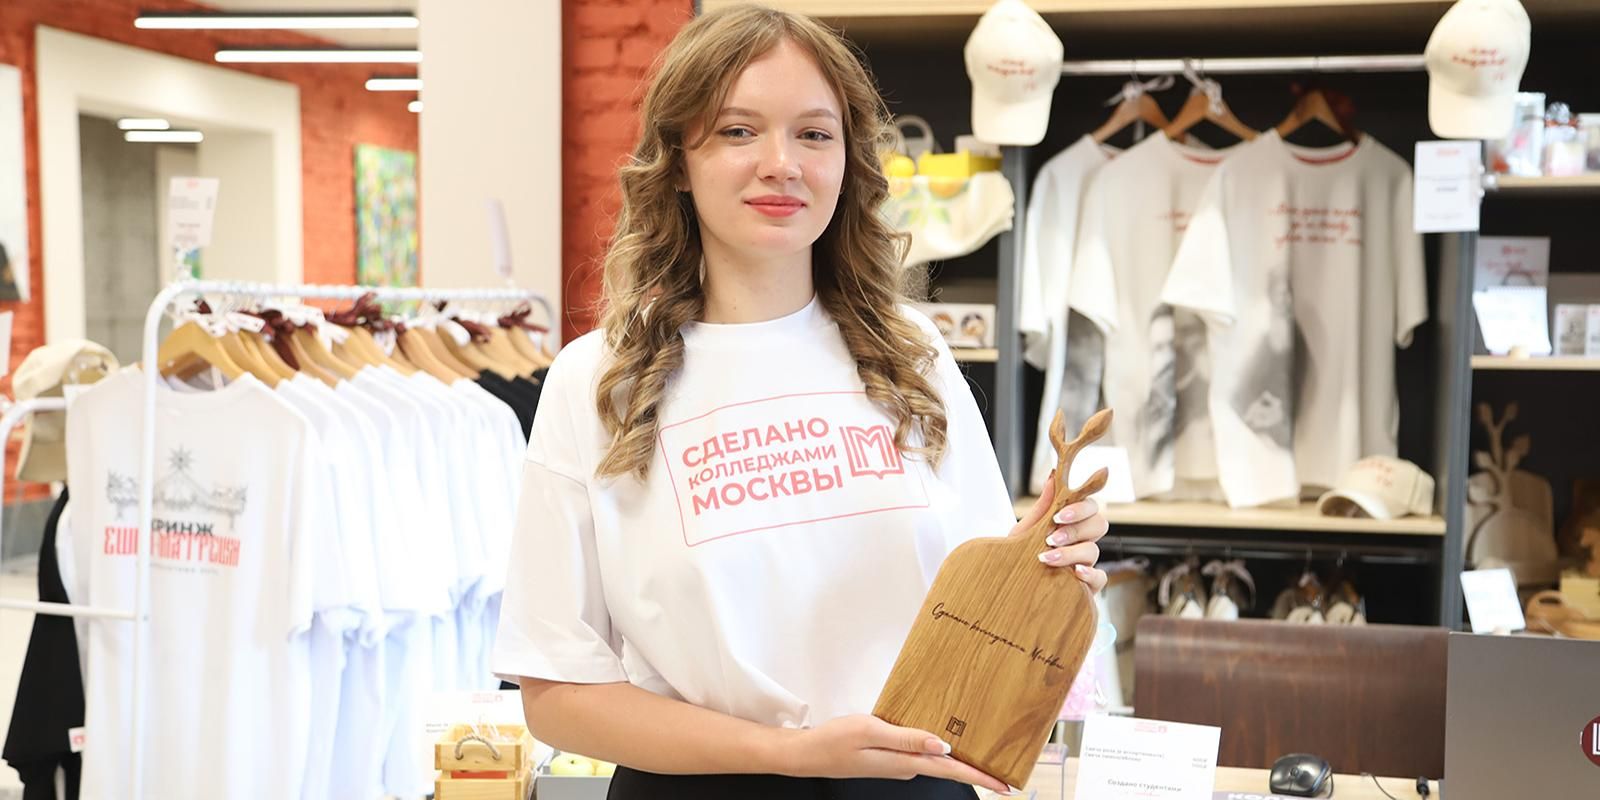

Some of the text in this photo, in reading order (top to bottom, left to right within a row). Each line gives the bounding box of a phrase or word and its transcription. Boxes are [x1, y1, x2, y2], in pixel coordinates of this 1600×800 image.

[682, 417, 829, 468] СДЕЛАНО
[688, 444, 837, 490] КОЛЛЕДЖАМИ
[691, 465, 843, 516] МОСКВЫ
